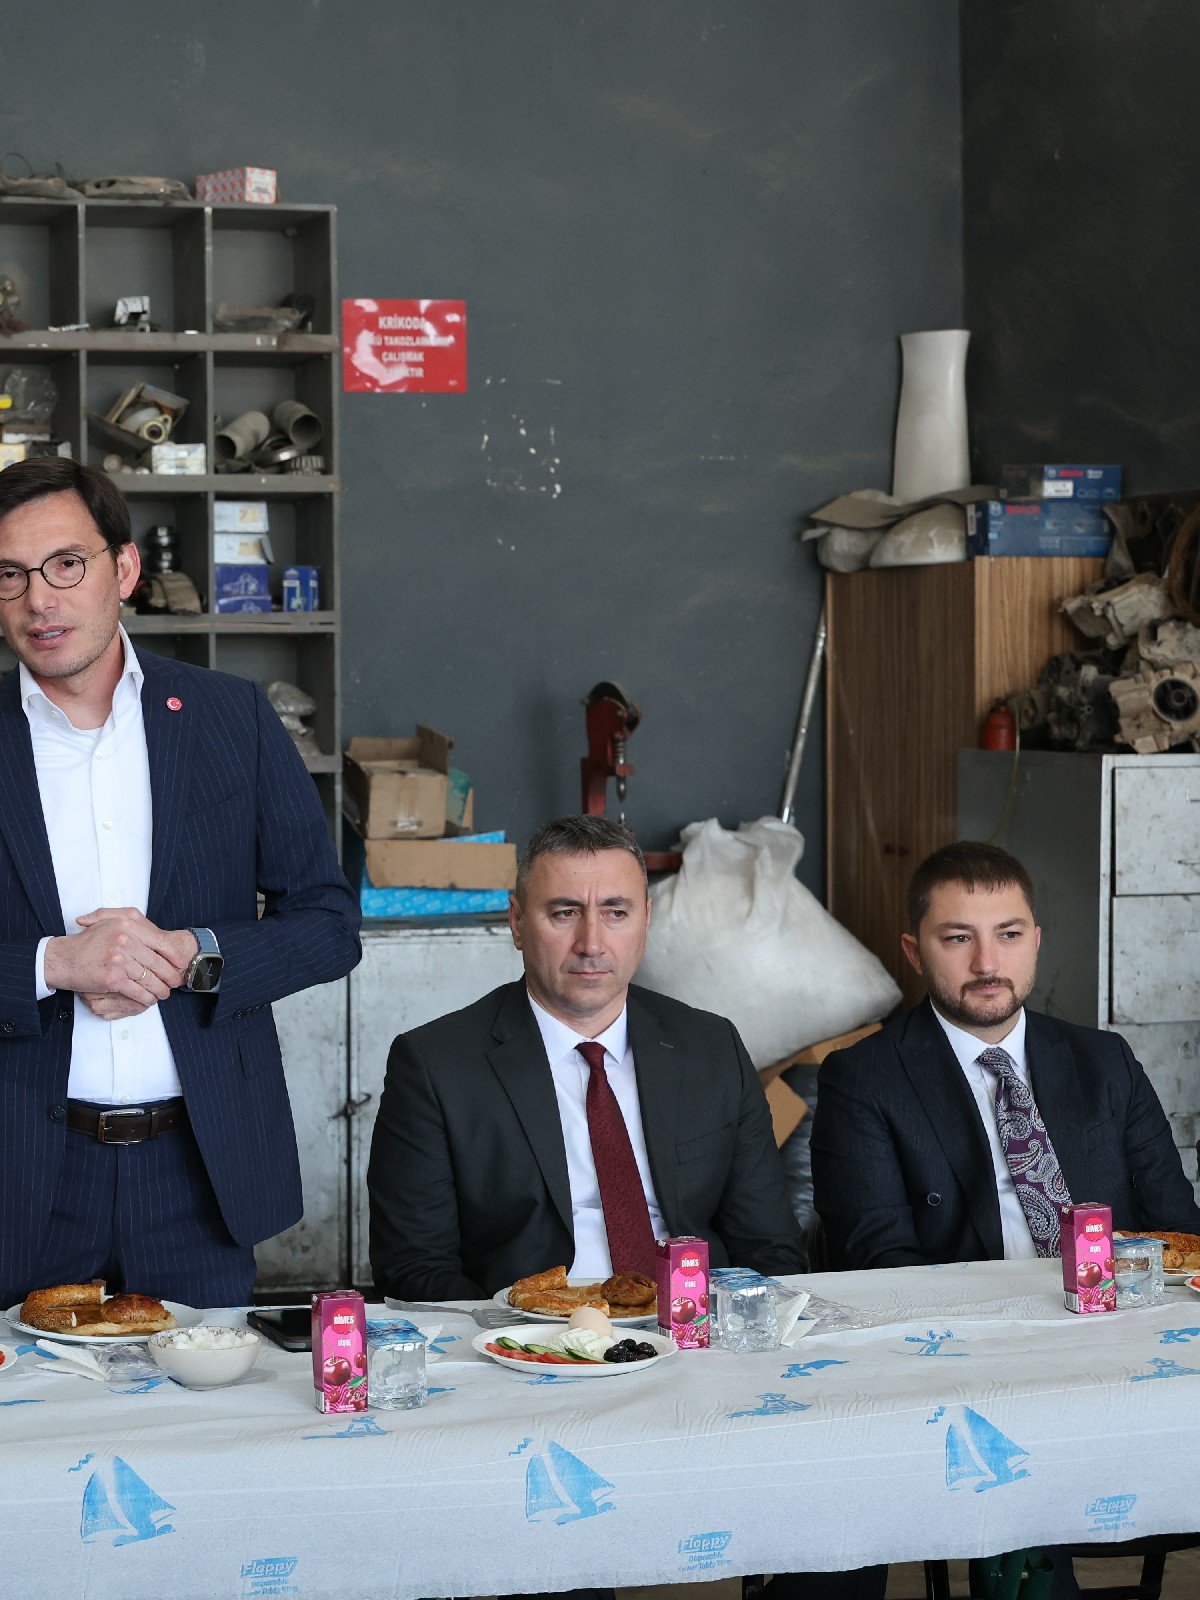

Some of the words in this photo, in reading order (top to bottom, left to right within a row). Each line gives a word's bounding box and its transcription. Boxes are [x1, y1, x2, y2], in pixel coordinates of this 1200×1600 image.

[333, 1314, 354, 1325] DİMES
[680, 1534, 730, 1551] Floppy
[242, 1559, 295, 1576] Floppy
